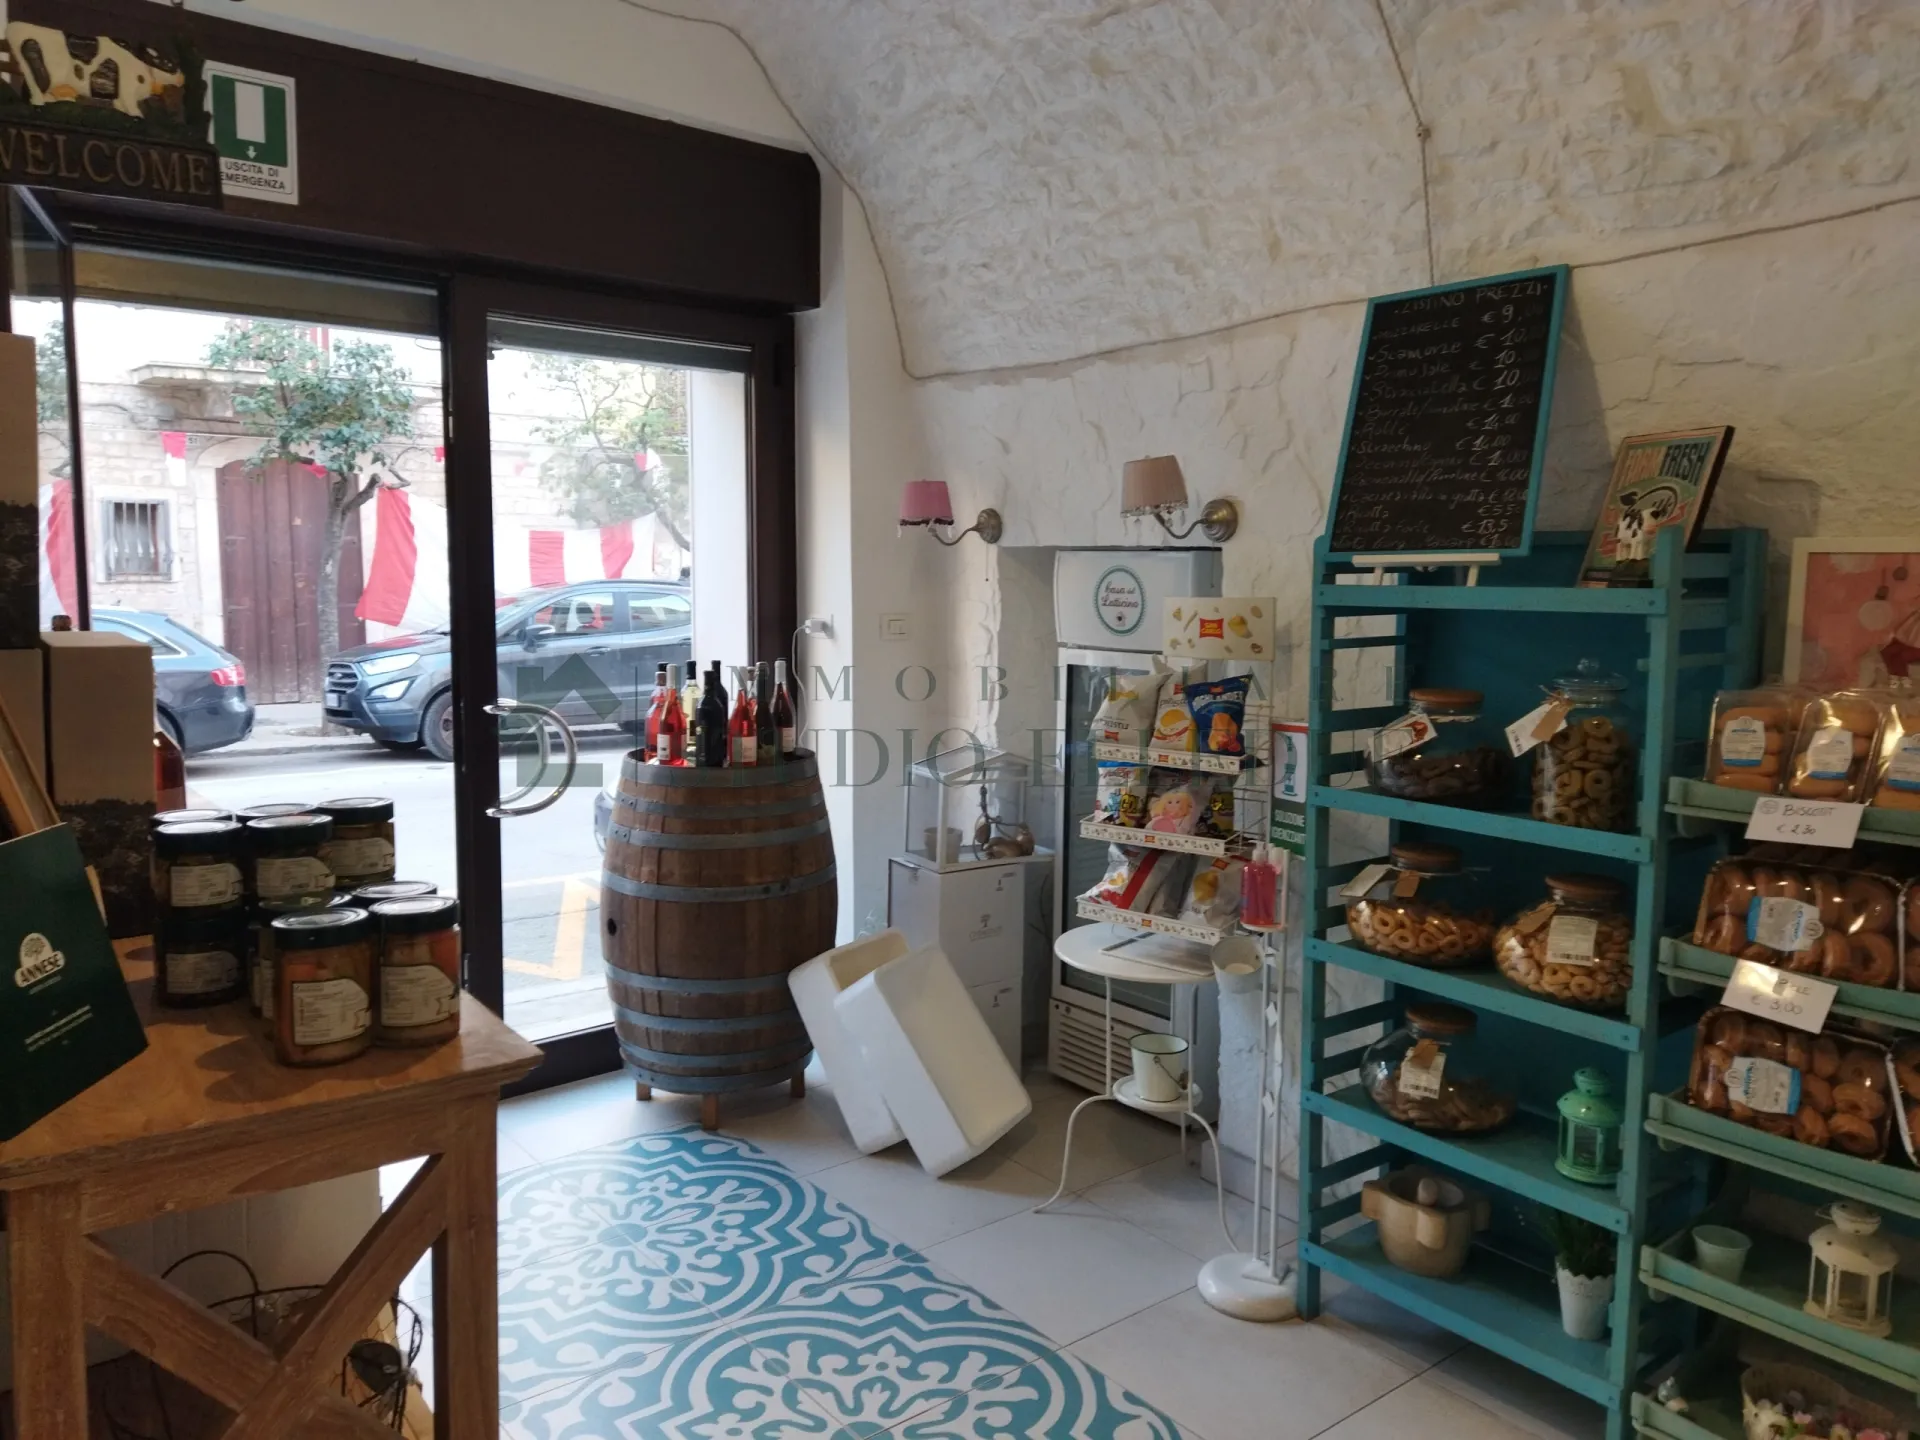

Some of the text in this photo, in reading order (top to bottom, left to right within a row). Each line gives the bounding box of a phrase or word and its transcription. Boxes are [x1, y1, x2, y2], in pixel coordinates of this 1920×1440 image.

[220, 171, 285, 189] EMERGENZA
[225, 161, 279, 177] USCITA DI
[1659, 441, 1710, 486] FRESH
[20, 952, 61, 983] ANNESE
